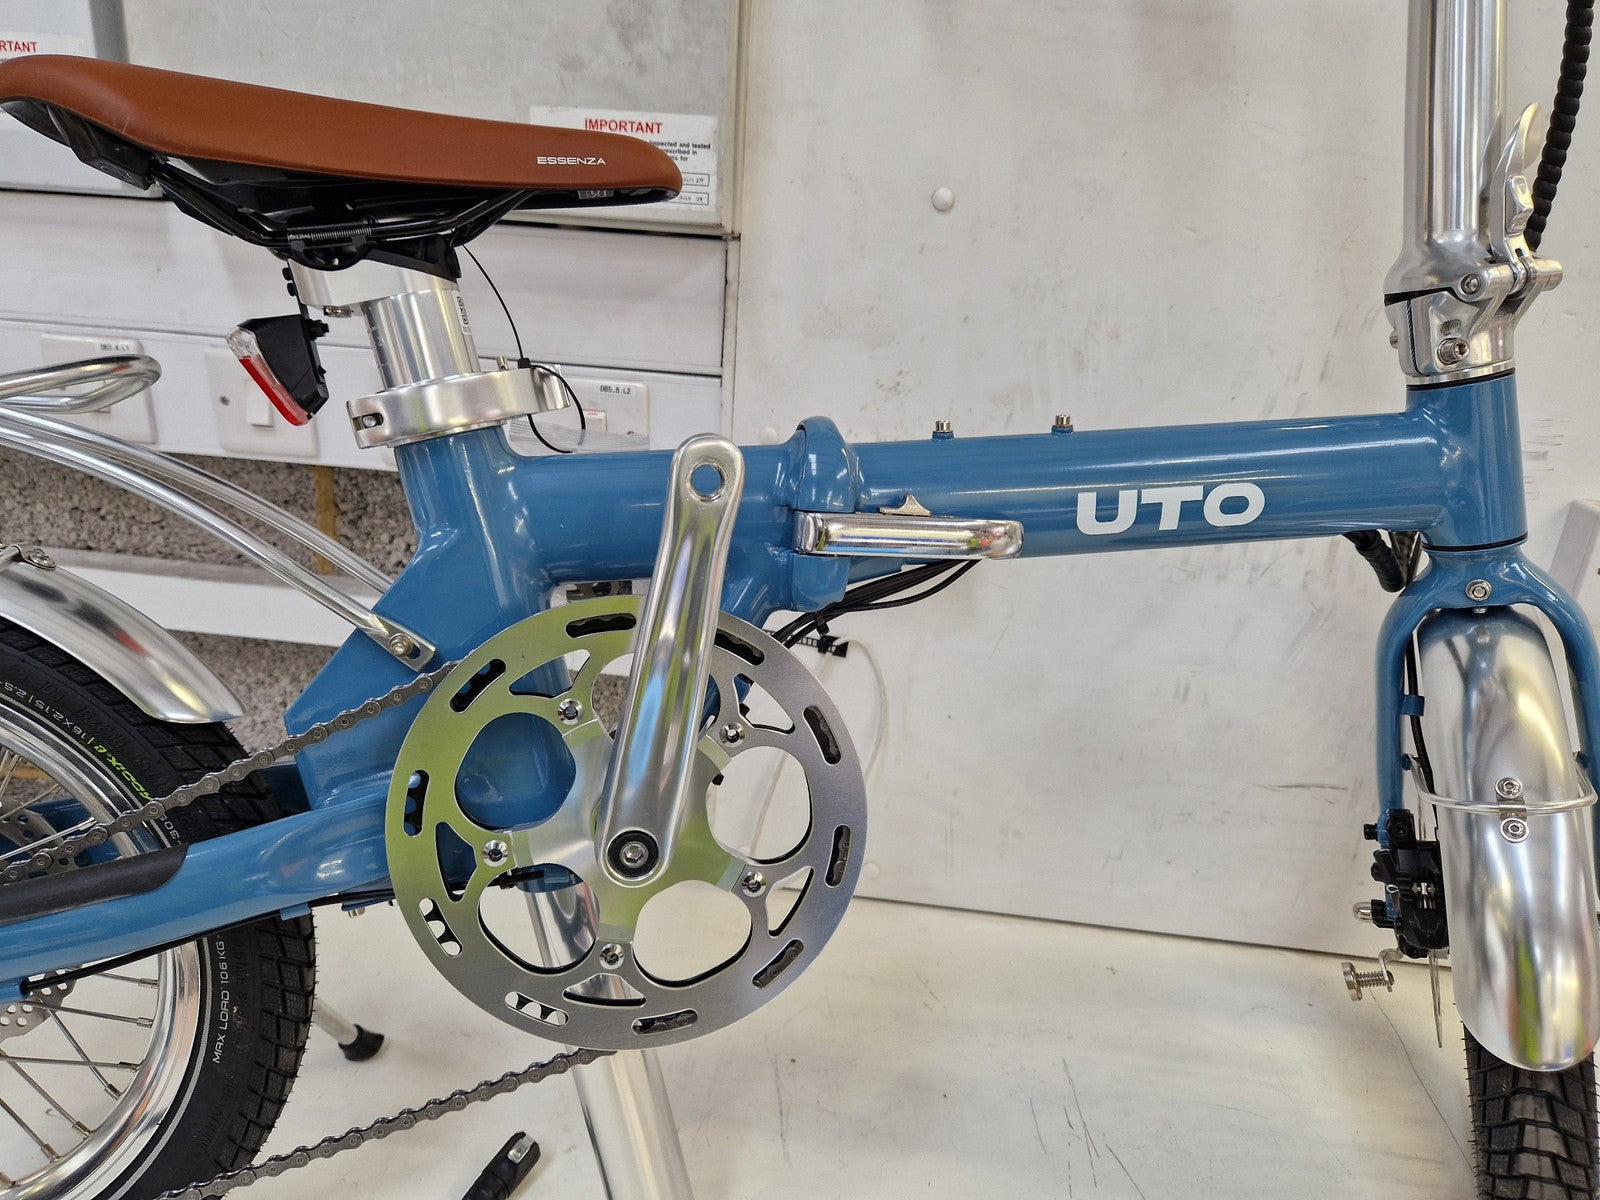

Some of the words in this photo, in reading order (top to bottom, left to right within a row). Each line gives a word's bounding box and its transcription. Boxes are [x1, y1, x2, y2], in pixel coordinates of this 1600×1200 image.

[0, 40, 37, 52] RTANT
[584, 118, 663, 134] IMPORTANT
[537, 156, 606, 165] ESSENZA
[1076, 482, 1266, 535] UTO
[34, 699, 87, 740] 16X2.15
[215, 941, 227, 959] KG
[218, 961, 229, 984] 106
[219, 990, 230, 1030] LOAD
[212, 1033, 226, 1064] MAX
